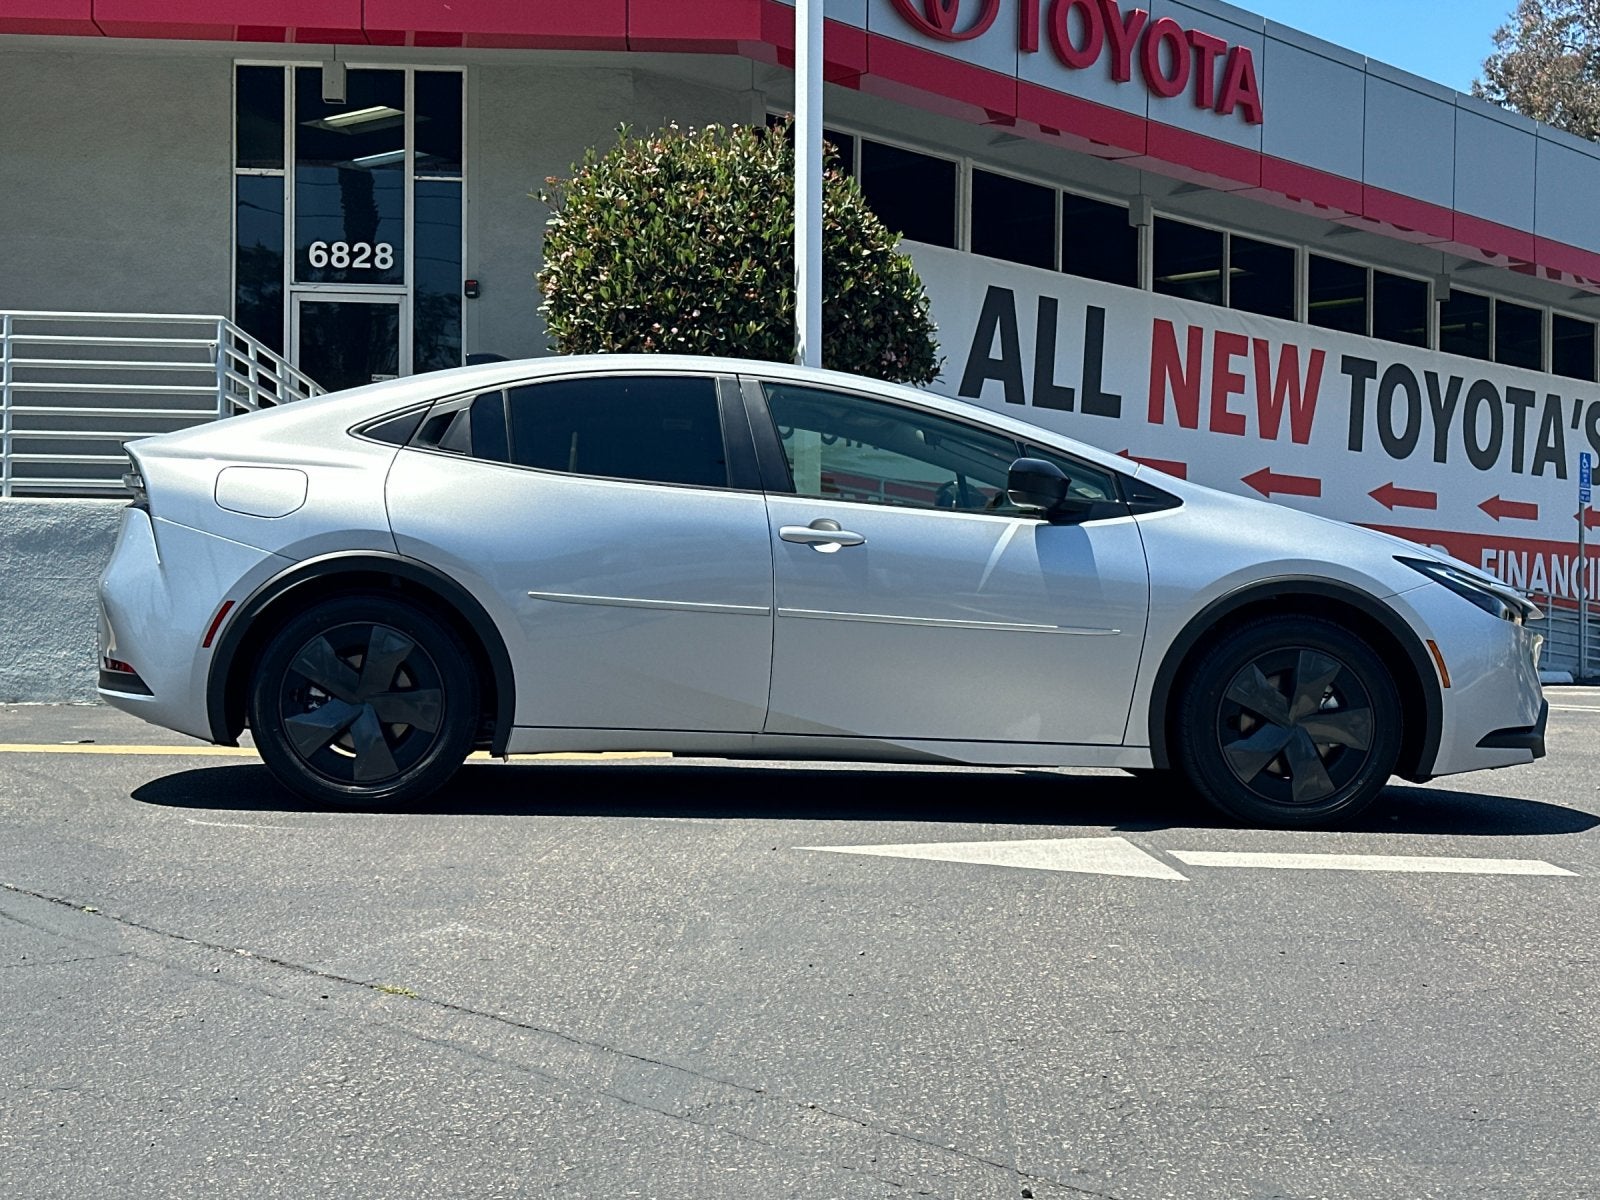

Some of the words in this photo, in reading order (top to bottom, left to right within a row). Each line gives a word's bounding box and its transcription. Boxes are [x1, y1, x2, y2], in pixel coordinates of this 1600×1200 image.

[308, 241, 394, 270] 6828
[958, 285, 1122, 419] ALL
[1147, 317, 1327, 446] NEW
[1481, 548, 1600, 600] FINANCI
